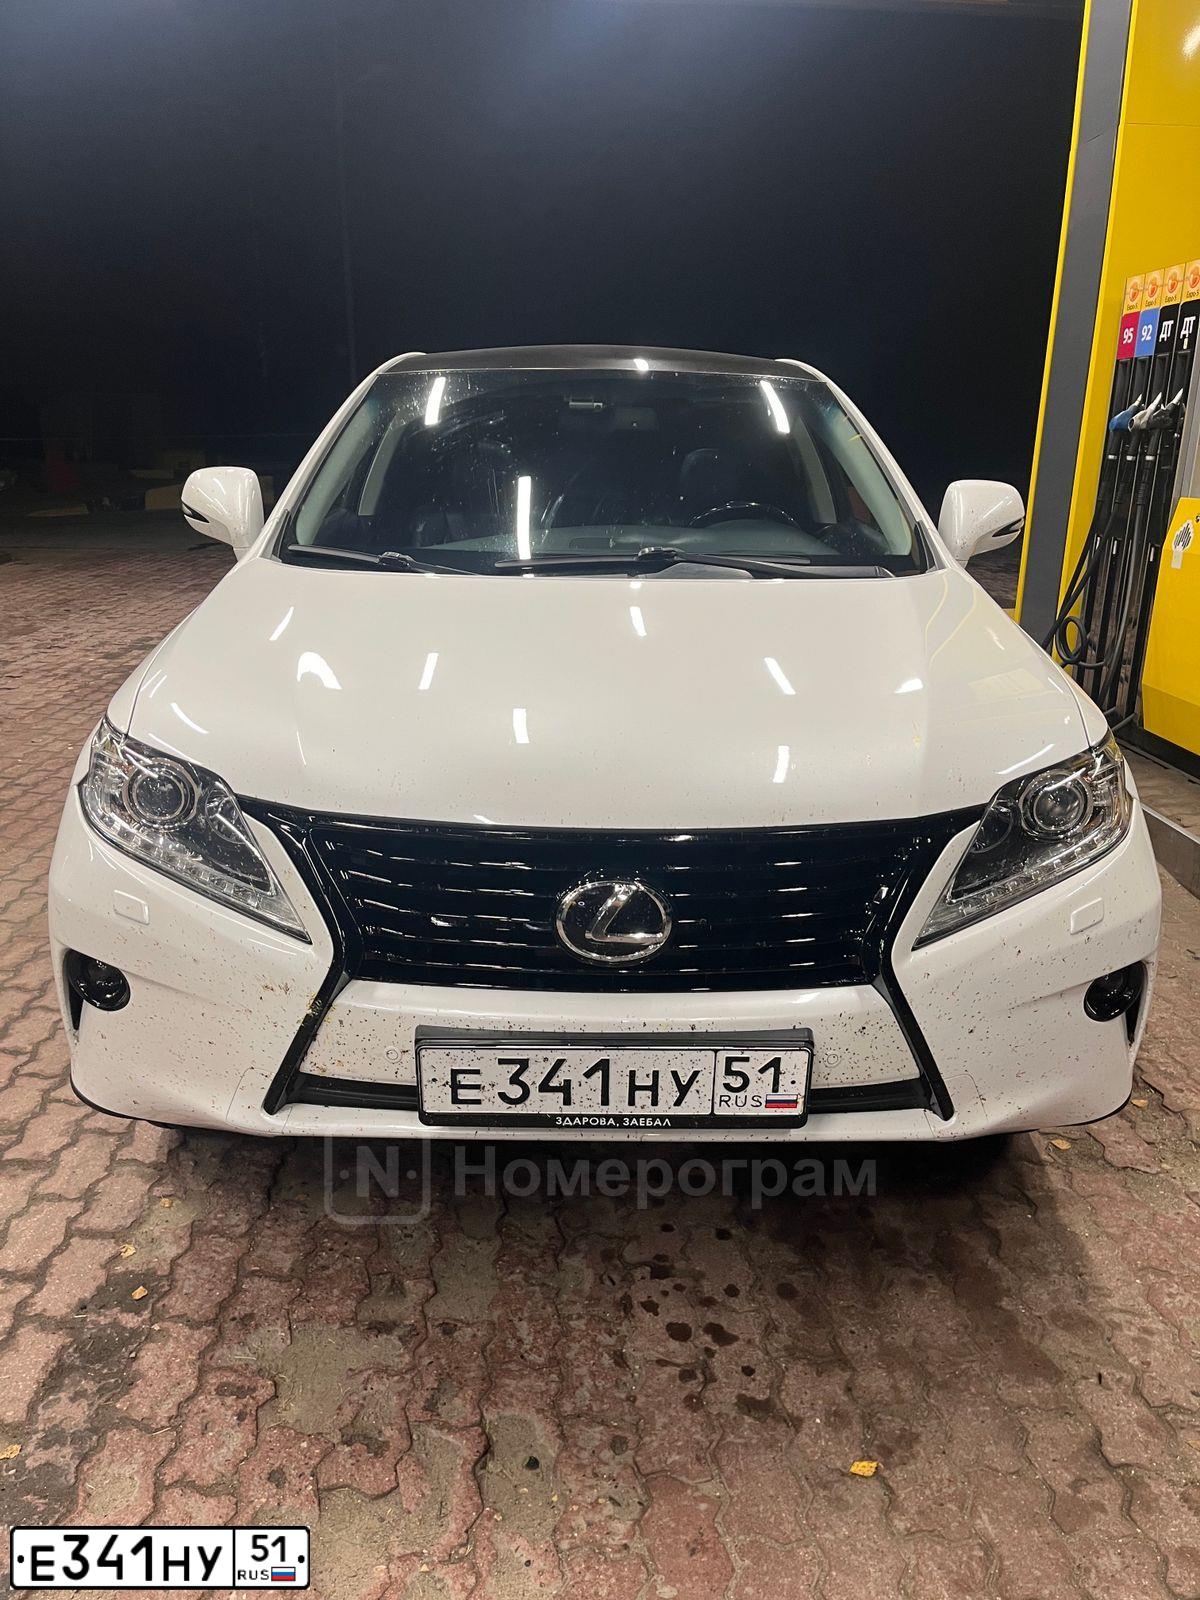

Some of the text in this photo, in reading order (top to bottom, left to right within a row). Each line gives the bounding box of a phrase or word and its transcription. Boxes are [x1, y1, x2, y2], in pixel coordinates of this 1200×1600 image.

[1123, 327, 1134, 344] 95
[1141, 324, 1153, 341] 92
[1159, 320, 1174, 342] ДТ
[1180, 316, 1196, 339] ДТ
[450, 1057, 700, 1107] Е341НУ
[722, 1056, 783, 1093] 51
[718, 1094, 762, 1108] RUS
[555, 1116, 672, 1127] ЗДАРОВА, ЗАЕБАЛ
